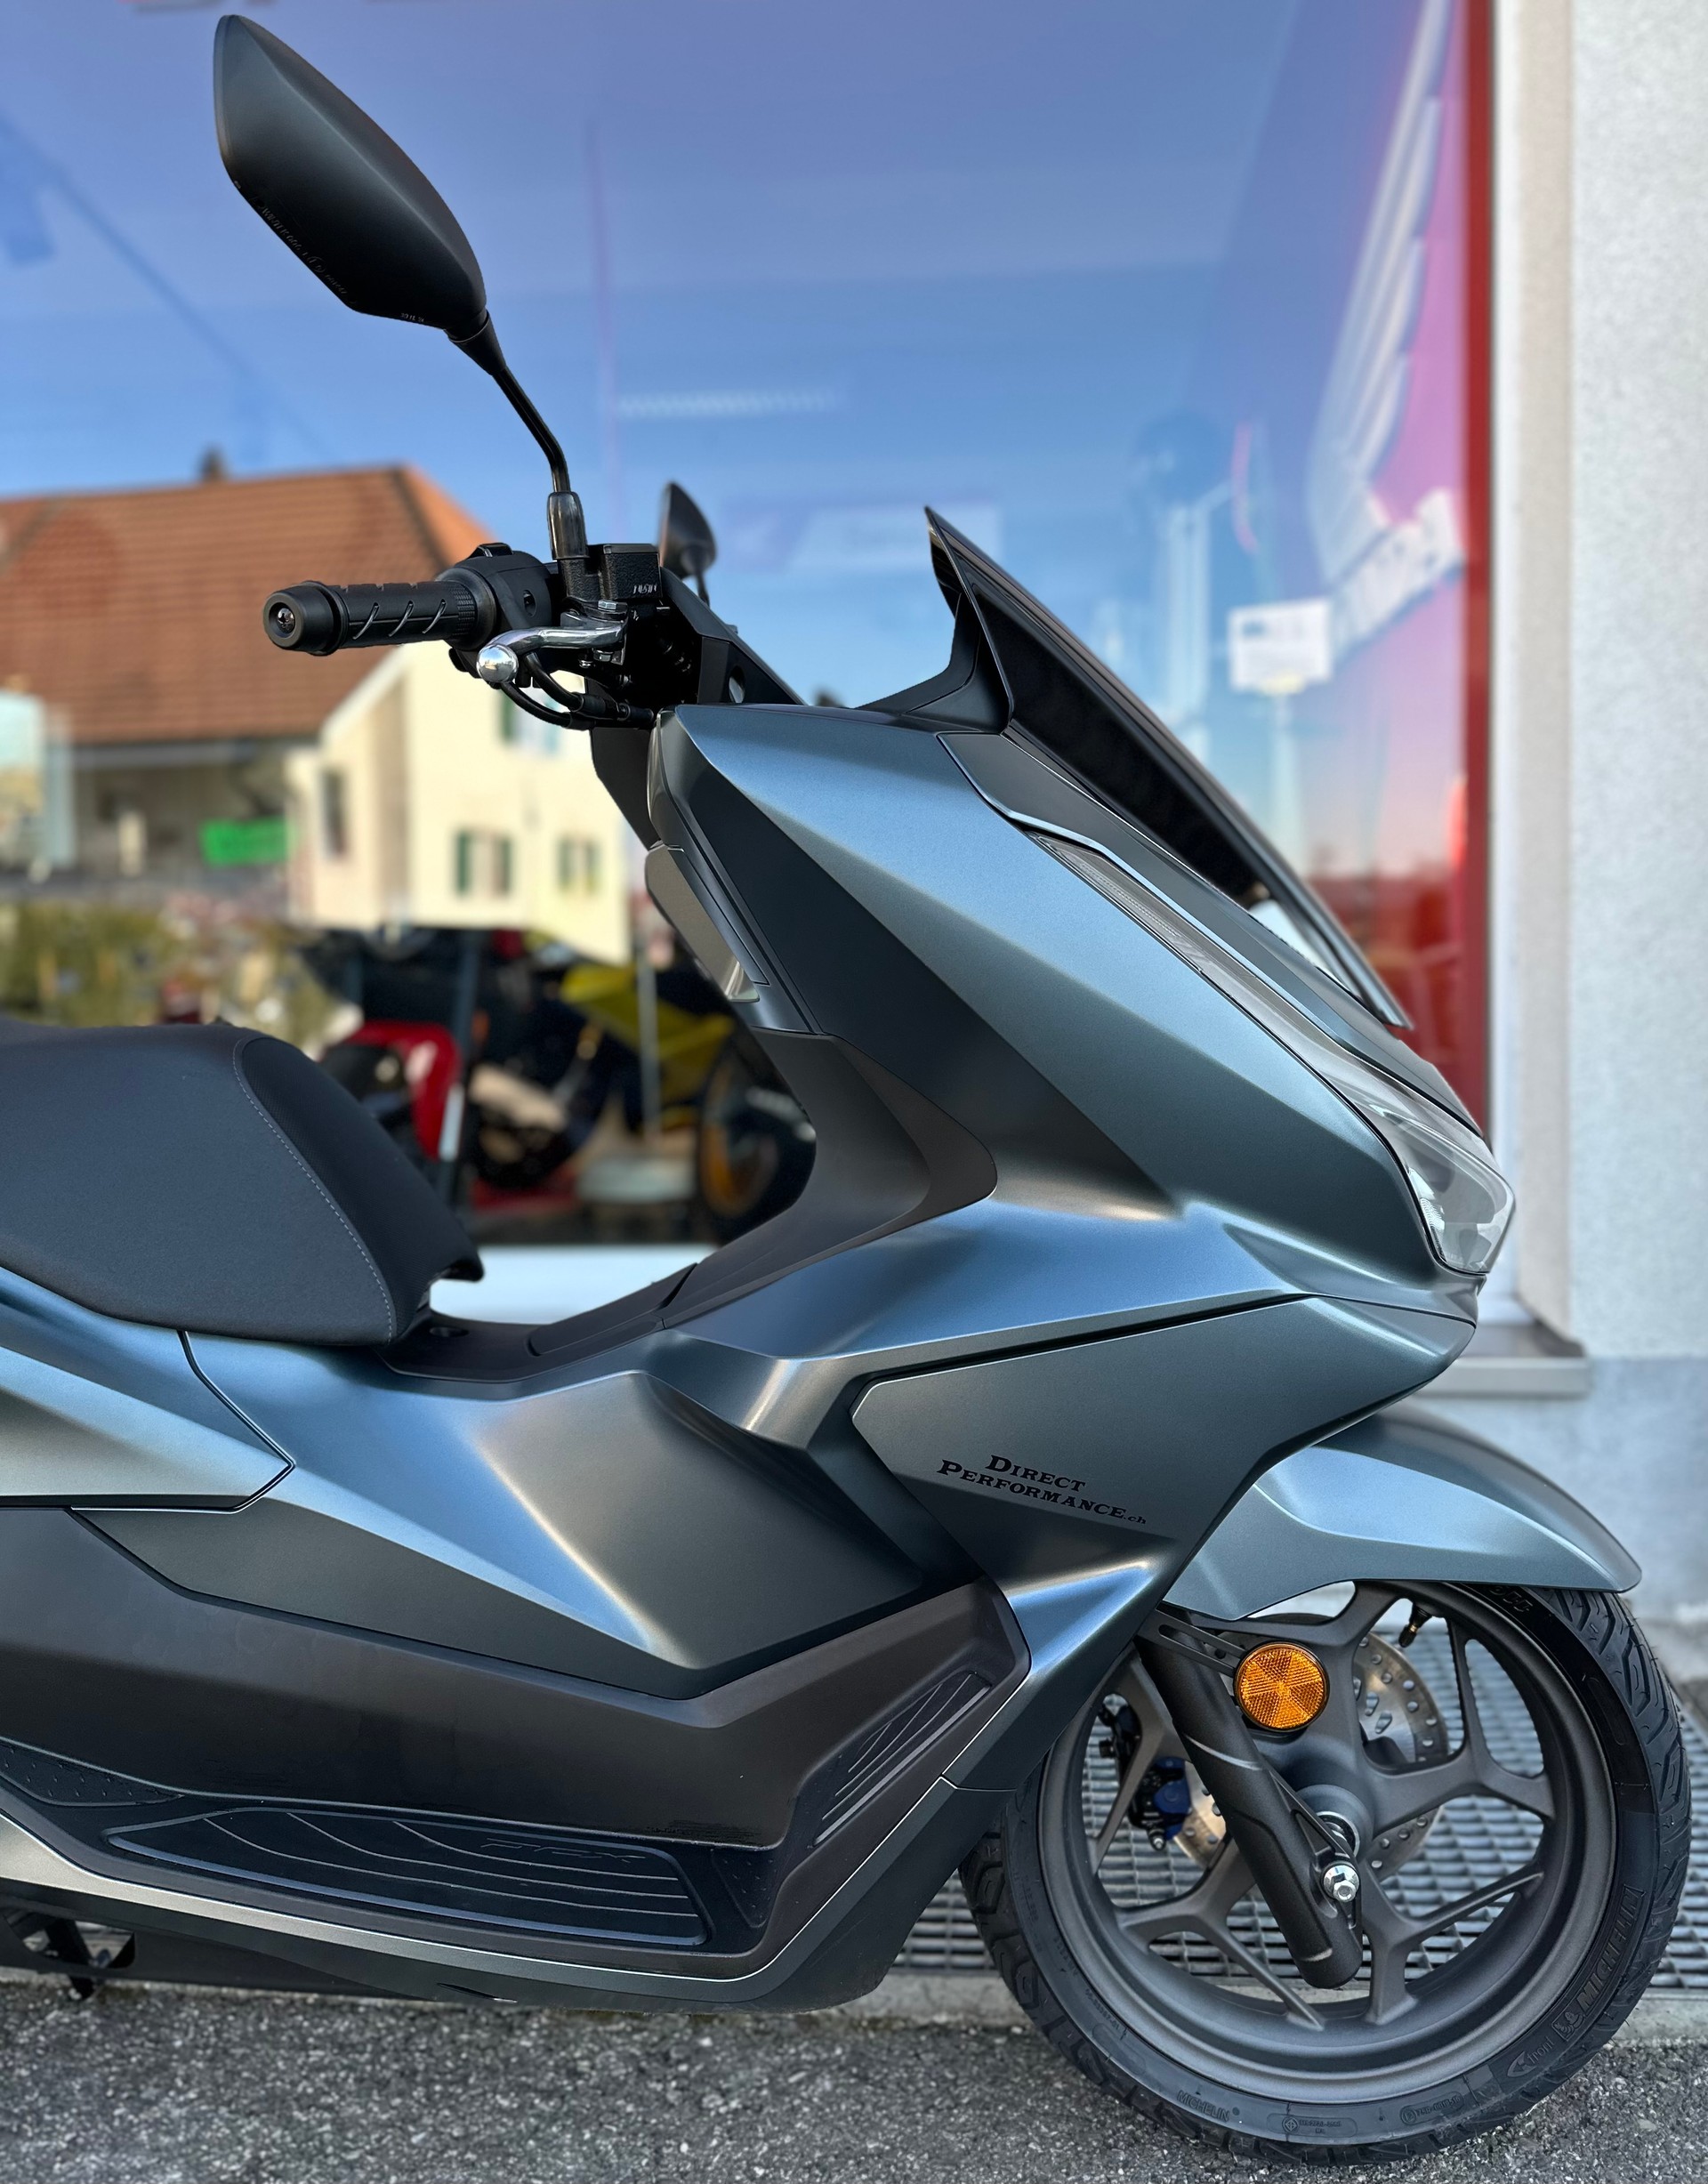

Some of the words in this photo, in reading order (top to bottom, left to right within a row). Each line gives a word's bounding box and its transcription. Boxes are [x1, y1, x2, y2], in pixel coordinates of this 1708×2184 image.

[937, 1459, 1147, 1525] PERFORMANCE.ch
[985, 1455, 1086, 1493] DIRECT
[1575, 1887, 1641, 2013] MICHELIN
[1527, 2035, 1555, 2065] front
[1176, 2090, 1230, 2123] MICHELIN
